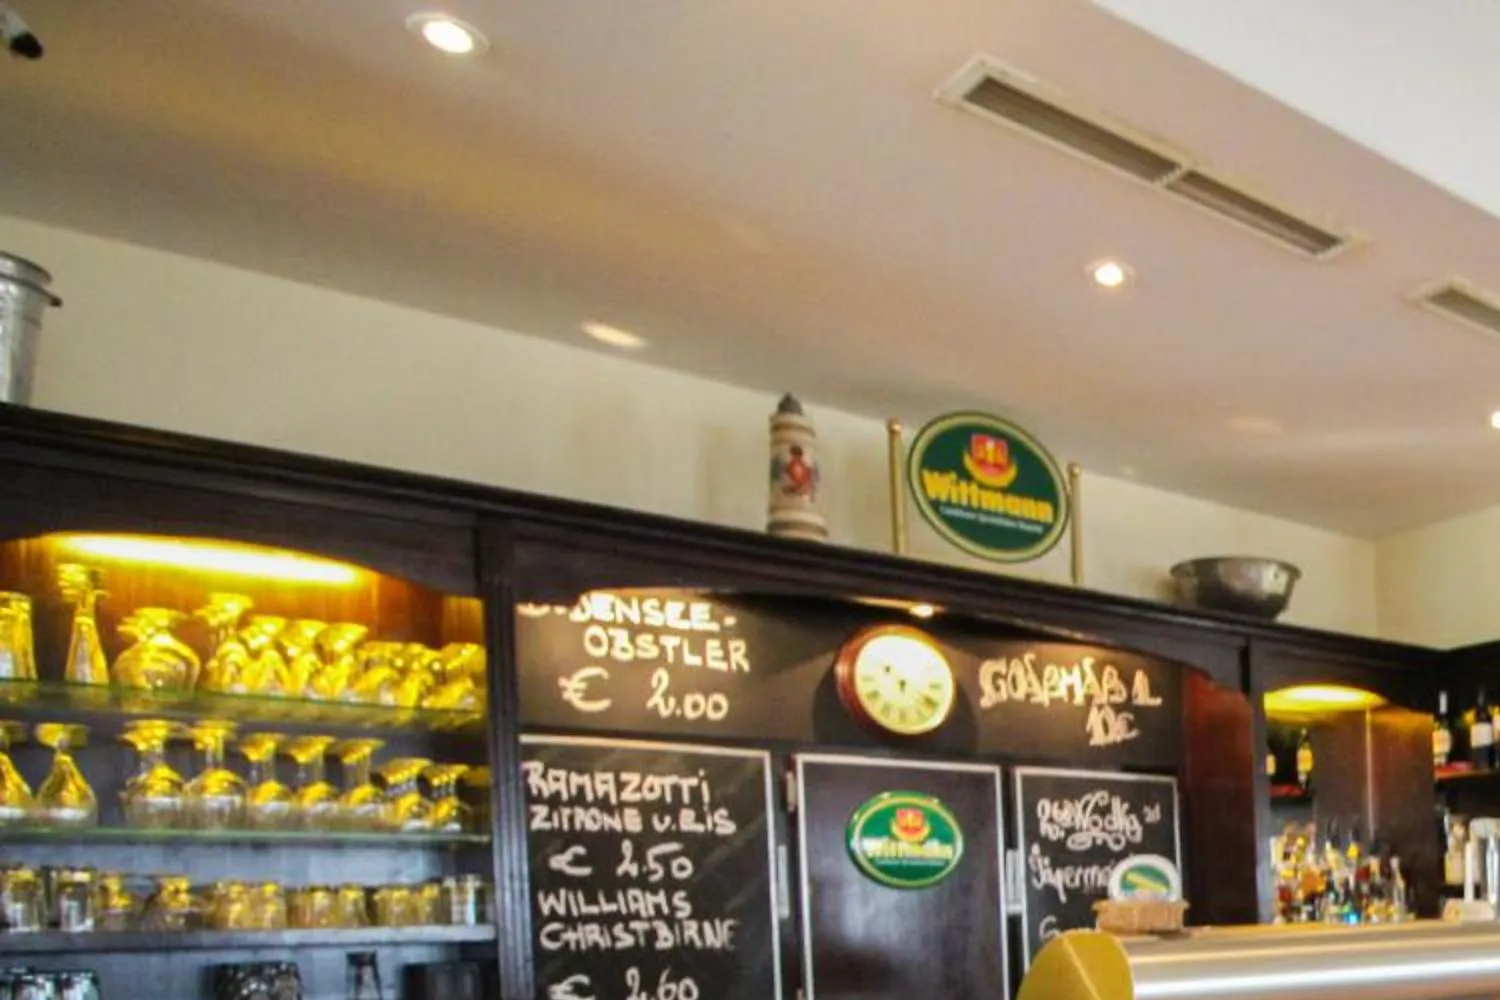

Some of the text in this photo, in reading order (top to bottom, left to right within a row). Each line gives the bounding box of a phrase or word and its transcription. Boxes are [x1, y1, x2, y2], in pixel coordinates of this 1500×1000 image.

[921, 468, 1054, 523] Wittmann
[583, 624, 750, 673] OBSTLER
[557, 665, 729, 720] € 2.00
[616, 838, 693, 881] 2.50
[537, 887, 692, 918] WILLIAMS
